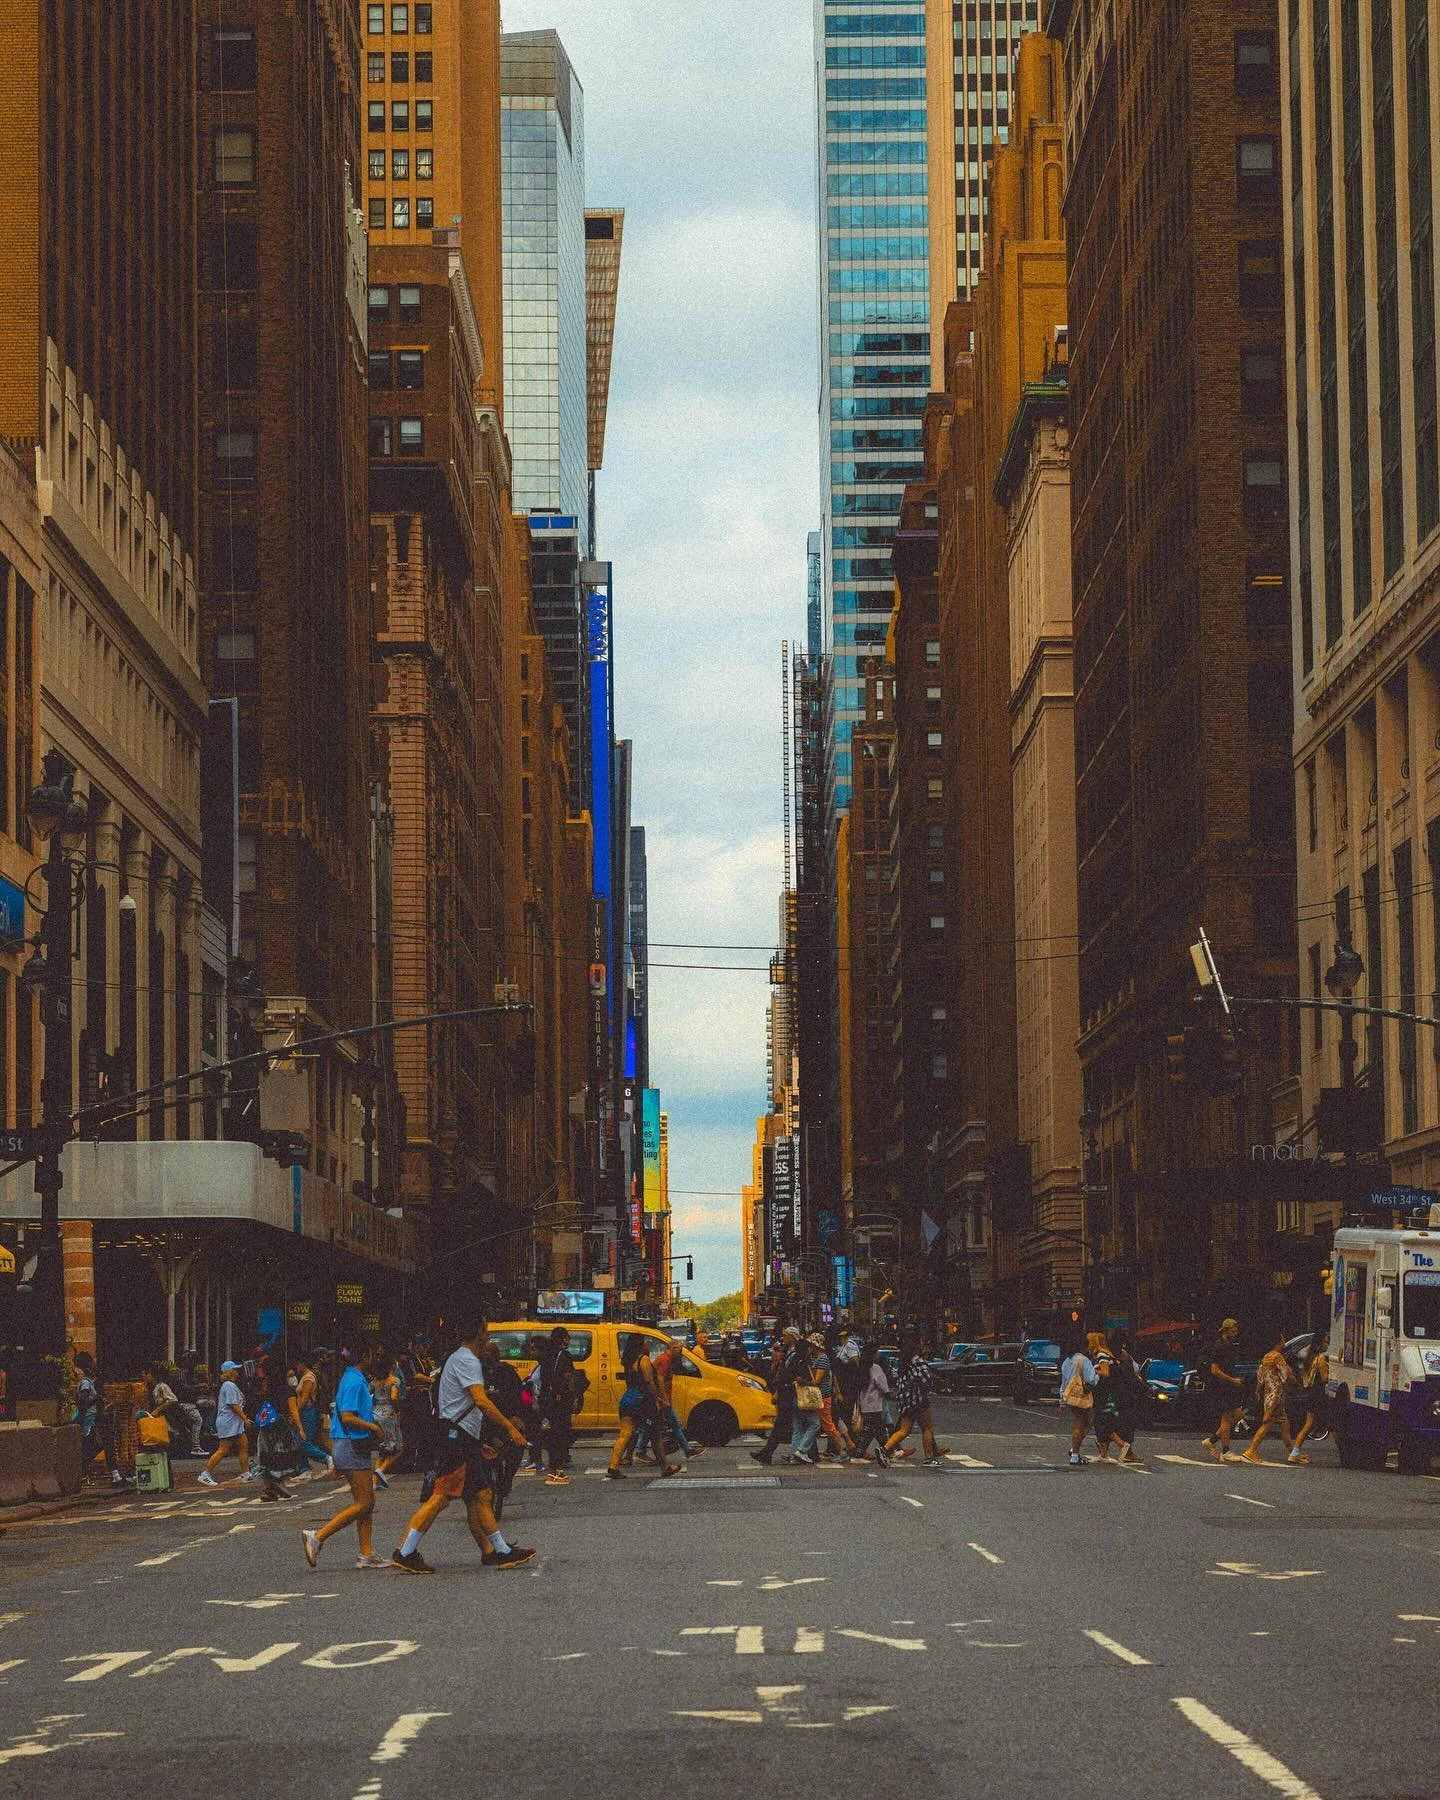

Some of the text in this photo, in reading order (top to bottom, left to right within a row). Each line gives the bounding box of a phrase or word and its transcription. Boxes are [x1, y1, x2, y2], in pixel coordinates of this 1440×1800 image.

[8, 1137, 23, 1151] St
[1371, 1193, 1397, 1205] West
[1421, 1195, 1432, 1206] St
[337, 1296, 362, 1304] ZONE
